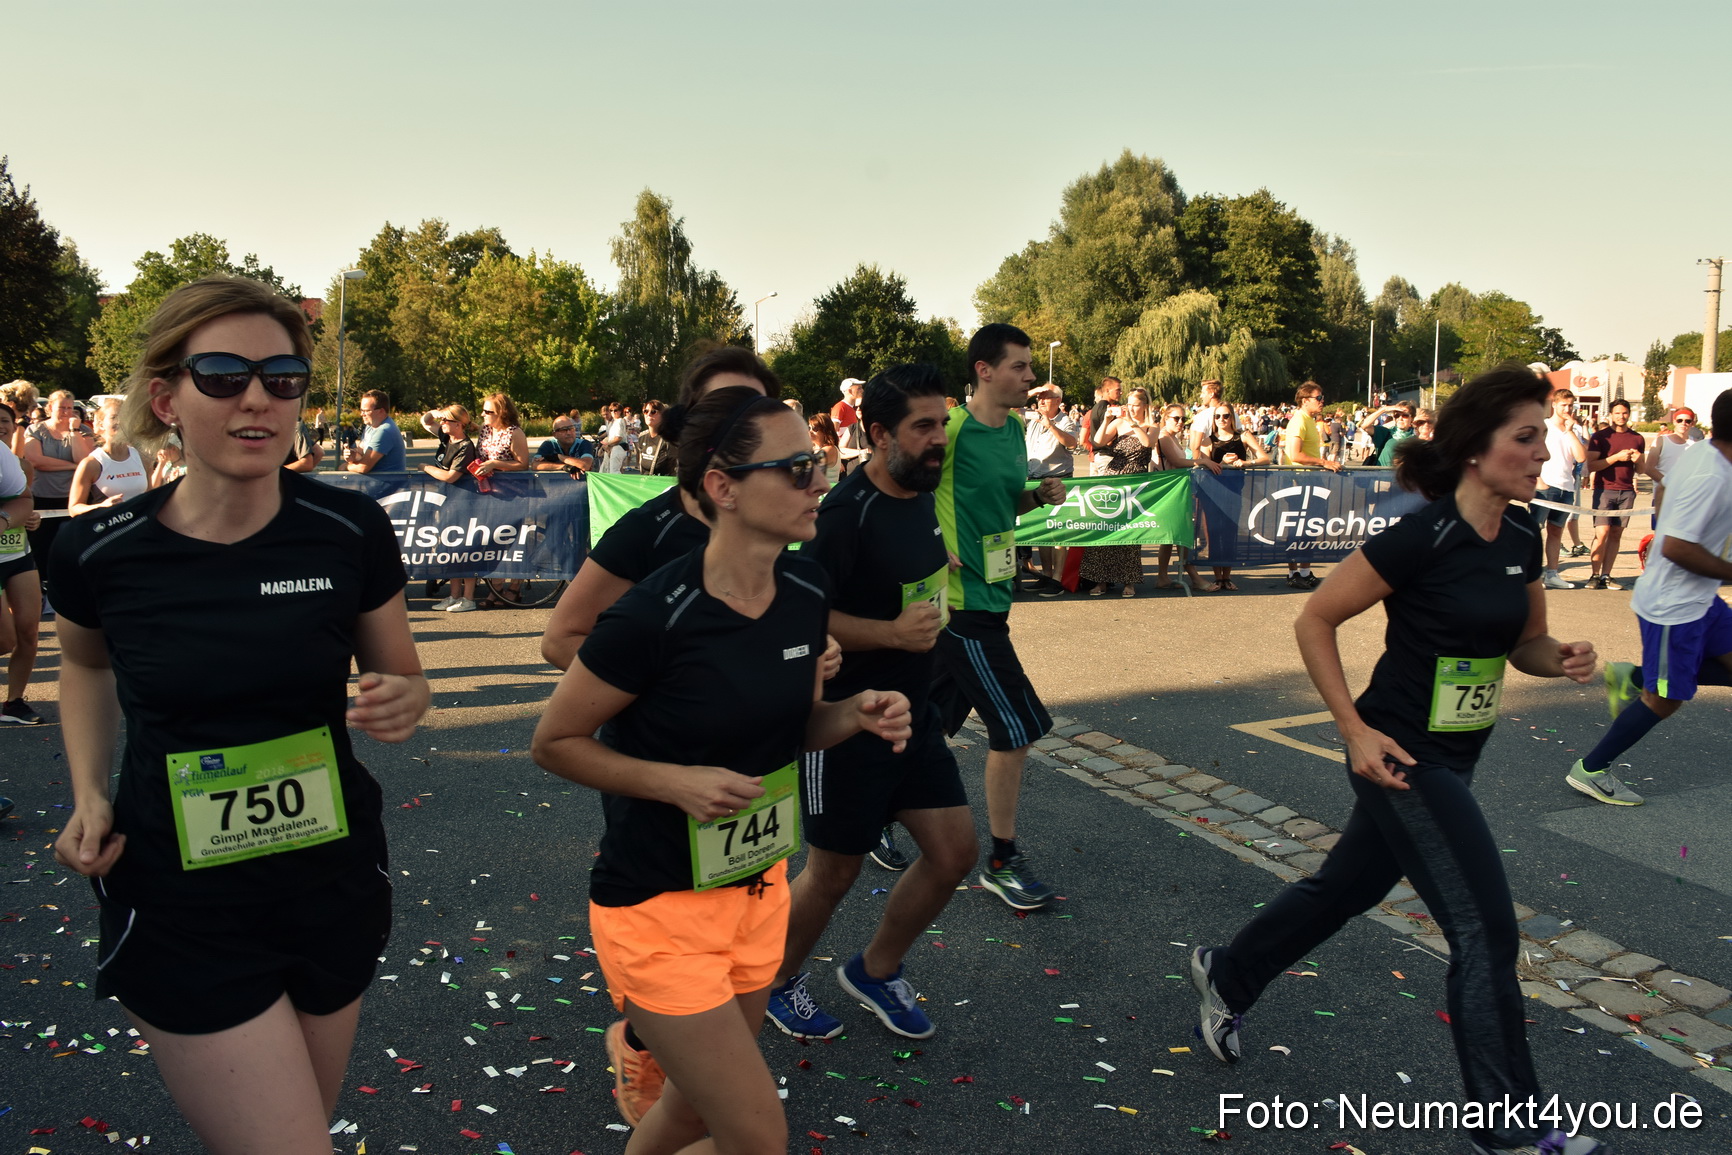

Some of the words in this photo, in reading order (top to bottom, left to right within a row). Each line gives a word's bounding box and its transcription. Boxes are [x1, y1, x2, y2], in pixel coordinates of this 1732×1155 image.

[1049, 481, 1156, 519] AOK
[107, 511, 134, 527] JAKO
[1046, 519, 1063, 530] Die
[1065, 520, 1160, 532] Gesundheitskasse.
[1285, 540, 1366, 552] AUTOMOB
[400, 550, 524, 565] AUTOMOBILE
[1005, 548, 1012, 565] 5
[260, 577, 334, 596] MAGDALENA
[1456, 683, 1496, 711] 752
[192, 763, 248, 781] firmenlauf
[209, 778, 305, 832] 750
[210, 829, 248, 846] Gimpl
[251, 817, 318, 838] Magdalena
[718, 805, 780, 857] 744
[201, 840, 256, 857] Grundschule
[257, 837, 268, 846] an
[269, 834, 284, 844] der
